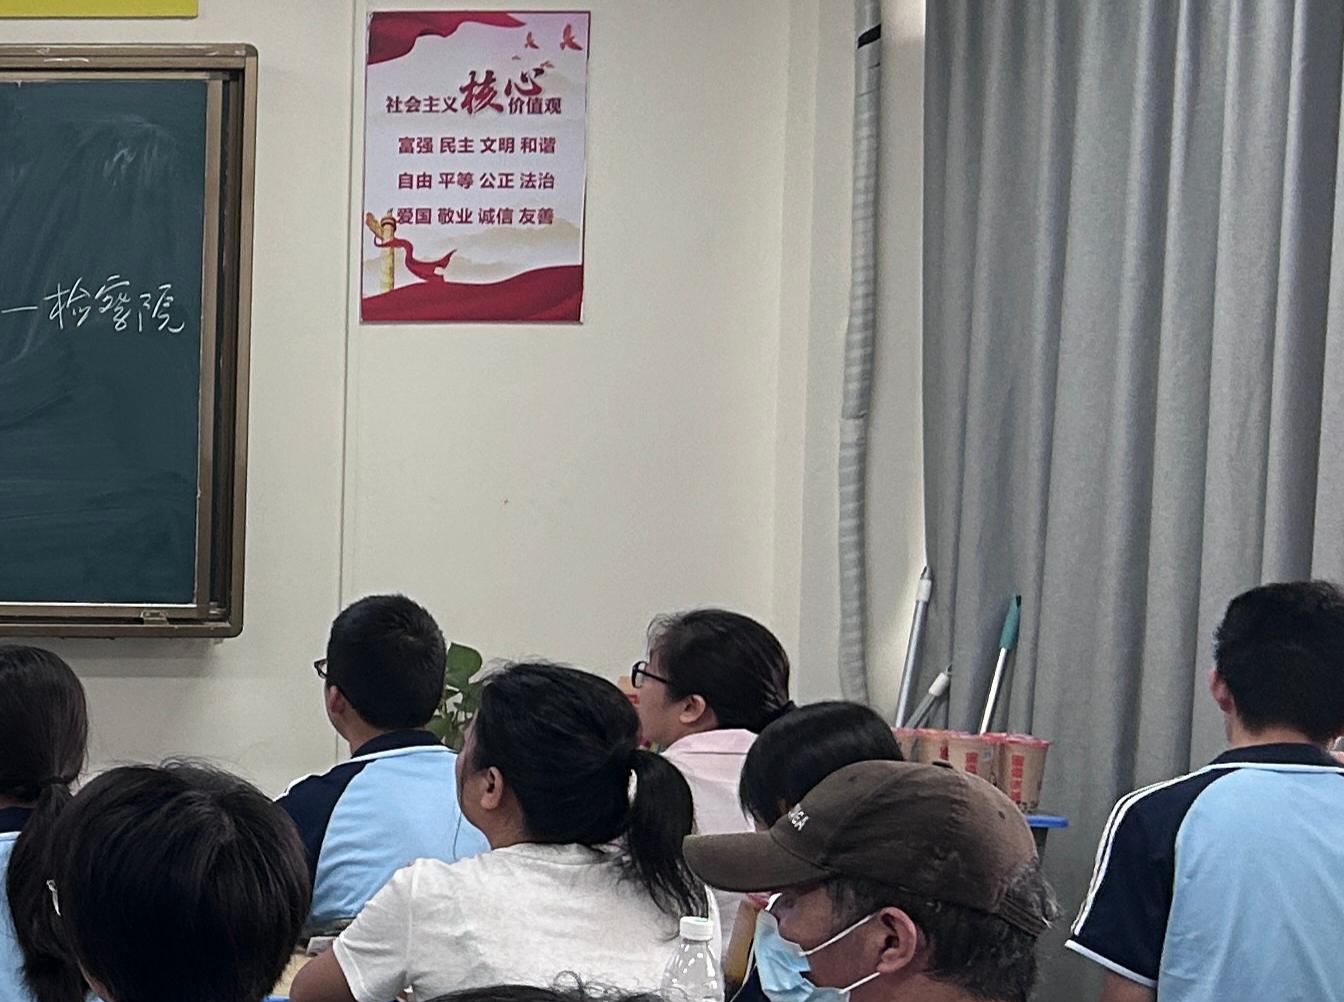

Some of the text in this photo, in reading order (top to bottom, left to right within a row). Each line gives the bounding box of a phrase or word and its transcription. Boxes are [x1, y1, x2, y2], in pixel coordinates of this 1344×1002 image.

[385, 95, 458, 114] 社会主义
[508, 96, 562, 115] 价值观
[398, 136, 556, 155] 富强 民主 文明 和谐
[398, 172, 555, 190] 自由 平等 公正 法治
[396, 207, 554, 226] 爱国 敬业 诚信 友善
